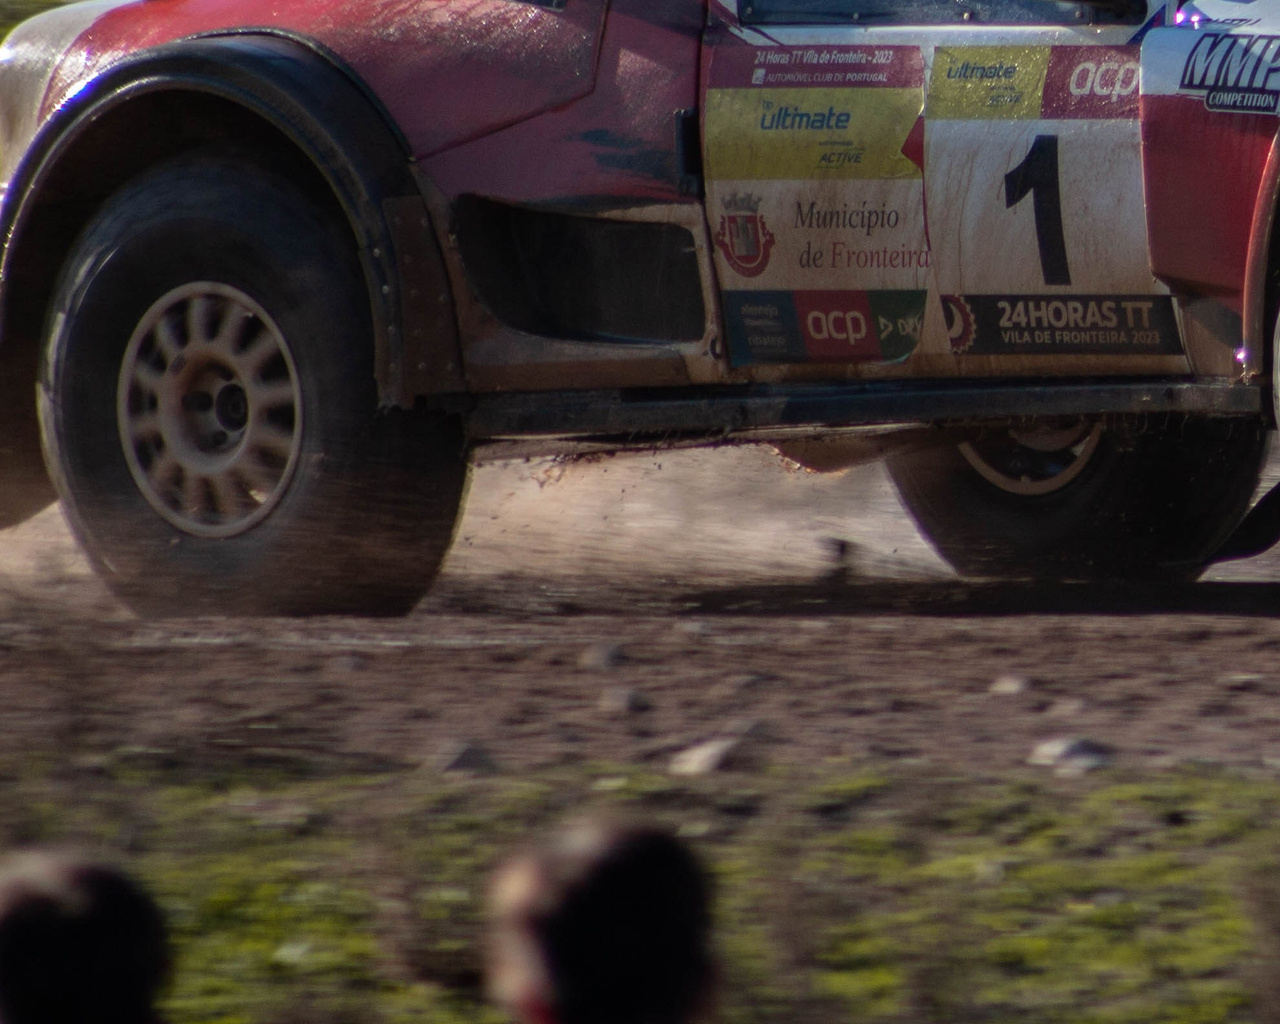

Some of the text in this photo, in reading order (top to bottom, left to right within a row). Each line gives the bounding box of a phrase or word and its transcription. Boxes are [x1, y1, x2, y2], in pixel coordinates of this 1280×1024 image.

[754, 51, 765, 64] 24
[766, 51, 789, 64] Horas
[791, 51, 802, 64] TT
[803, 50, 818, 64] Vila
[818, 50, 830, 64] de
[830, 50, 867, 64] Fronteira
[872, 50, 893, 64] 2023
[813, 73, 833, 82] CLUB
[834, 73, 845, 82] DE
[845, 73, 888, 82] PORTUGAL
[1069, 61, 1139, 103] acp
[1208, 92, 1277, 108] COMPETITION
[760, 106, 851, 131] ultimate
[819, 152, 864, 164] ACTIVE
[794, 201, 899, 236] Município
[1004, 134, 1072, 286] 1
[800, 241, 823, 269] de
[830, 241, 930, 269] Fronteira
[1120, 301, 1154, 327] TT
[807, 310, 867, 345] acp
[1001, 331, 1160, 345] VILA DE FRONTEIRA 2023
